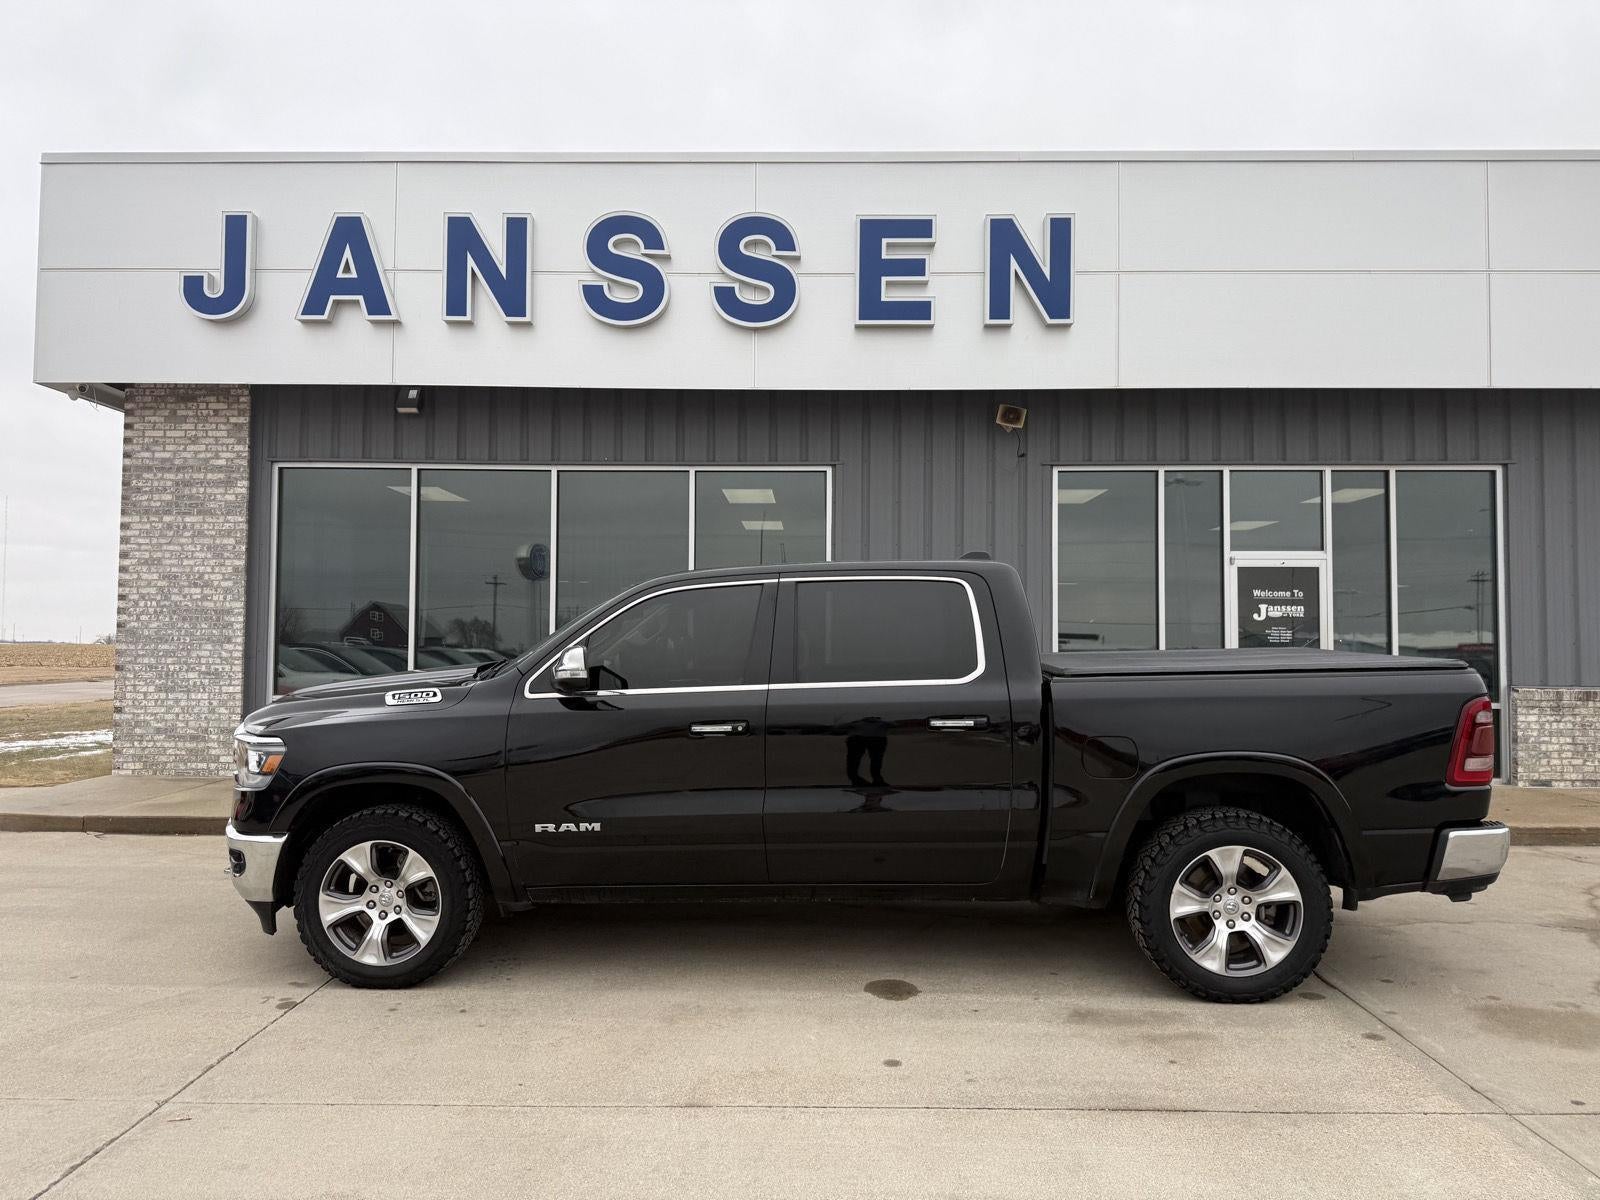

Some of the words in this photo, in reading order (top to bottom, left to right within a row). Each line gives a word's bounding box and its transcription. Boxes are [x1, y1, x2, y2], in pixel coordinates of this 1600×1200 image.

[178, 211, 1076, 328] JANSSEN
[1253, 589, 1291, 597] Welcome
[1253, 604, 1304, 620] Janssen
[394, 691, 434, 700] 1500
[535, 823, 601, 832] RAM
